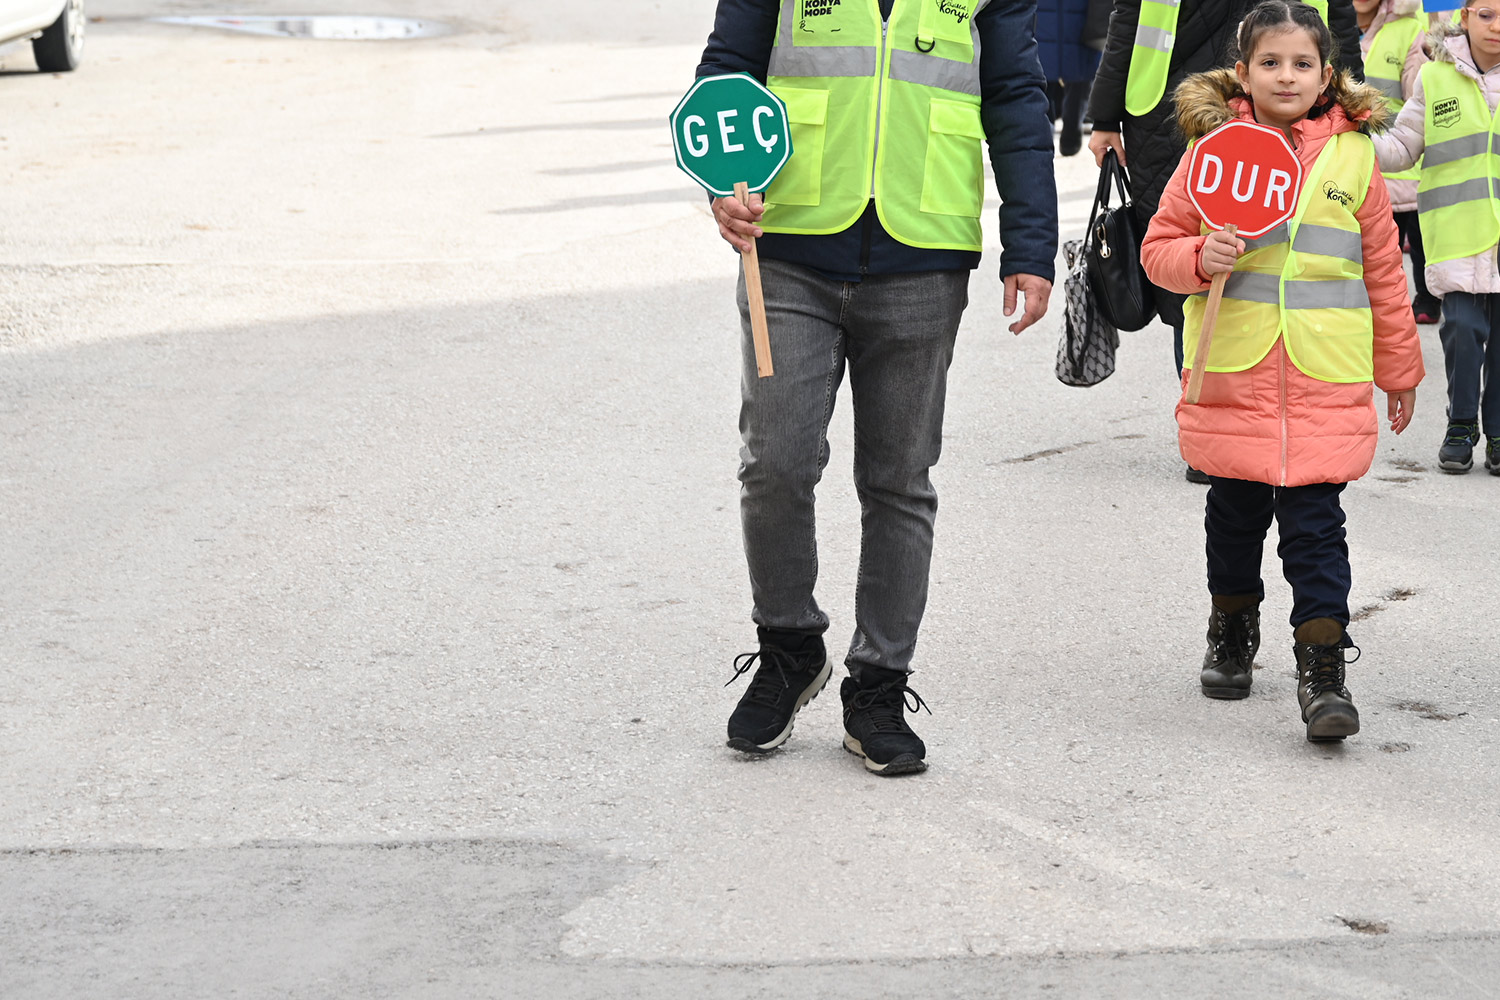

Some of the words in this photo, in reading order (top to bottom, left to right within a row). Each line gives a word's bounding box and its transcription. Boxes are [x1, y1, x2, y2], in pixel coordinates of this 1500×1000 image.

[804, 7, 832, 17] MODE
[1434, 99, 1457, 111] KONYA
[683, 105, 778, 158] GEÇ
[1196, 153, 1292, 211] DUR
